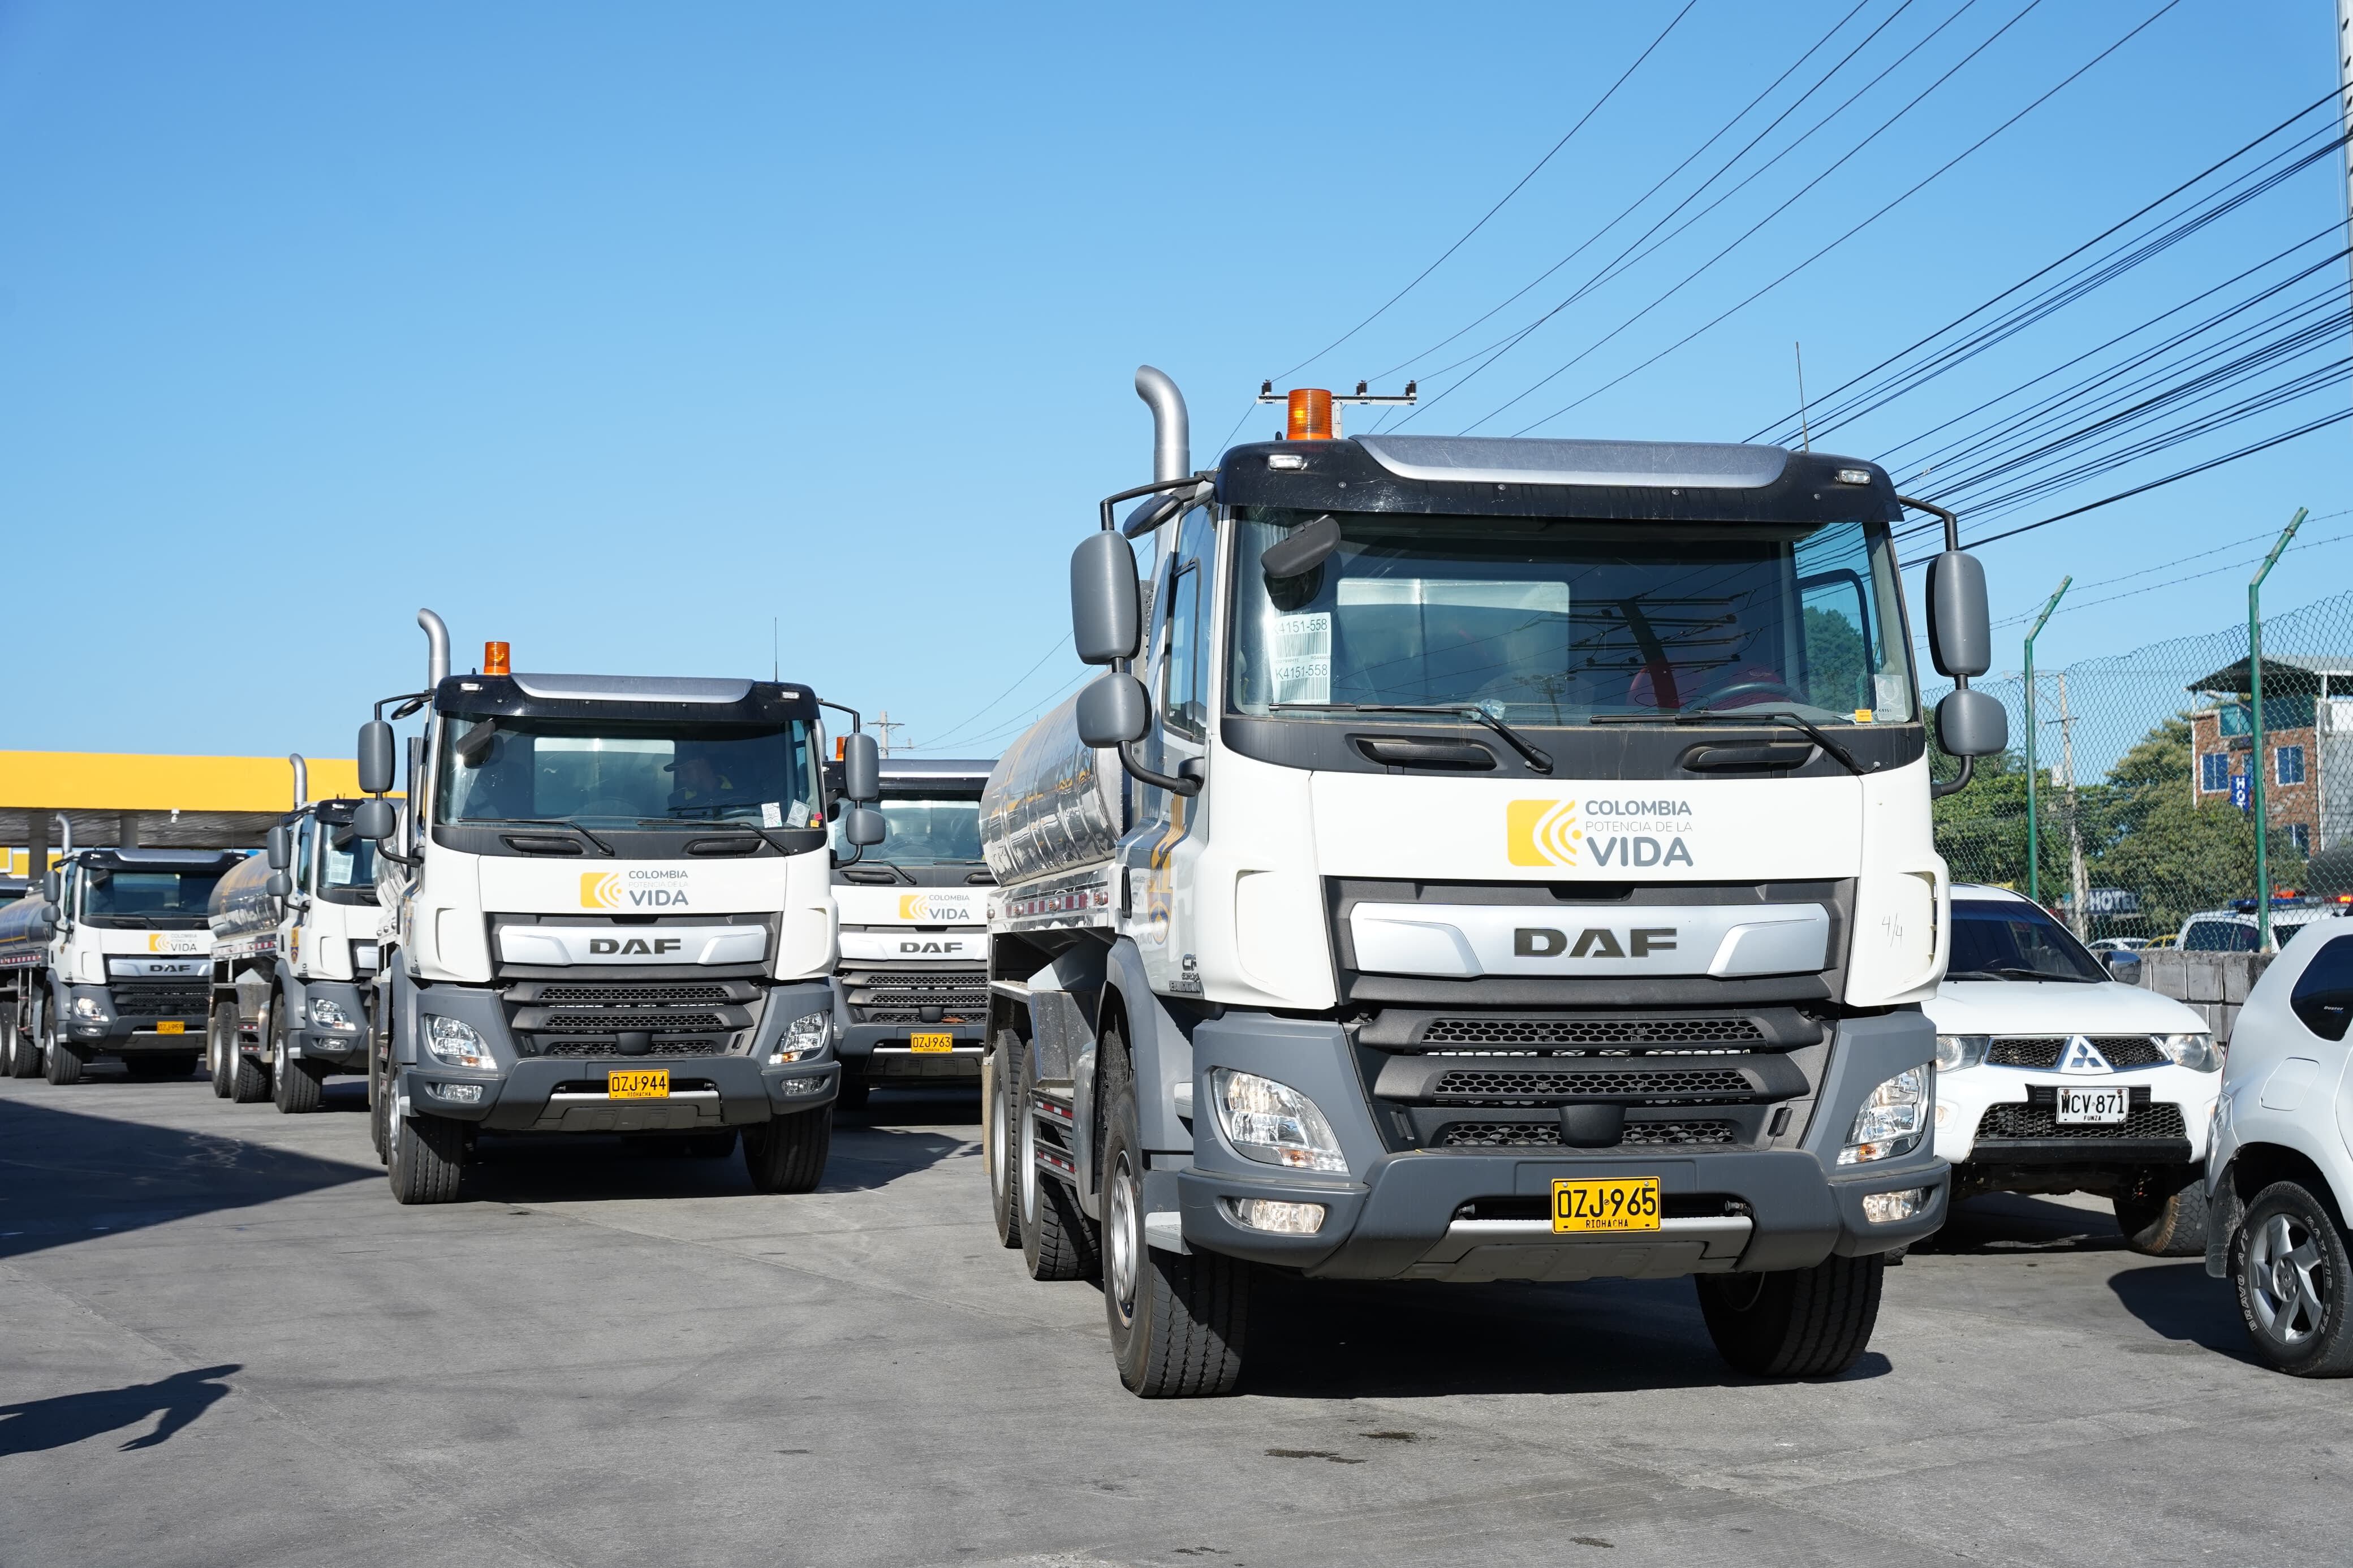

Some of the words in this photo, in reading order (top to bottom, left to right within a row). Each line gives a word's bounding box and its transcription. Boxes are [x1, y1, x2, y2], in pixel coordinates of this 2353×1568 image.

[1275, 664, 1328, 680] K4151-558
[1585, 800, 1692, 815] COLOMBIA
[1585, 822, 1652, 832] POTENCIA
[1656, 822, 1673, 832] DE
[1677, 822, 1693, 832] LA
[1586, 836, 1693, 867] VIDA
[629, 870, 688, 879] COLOMBIA
[629, 889, 689, 906] VIDA
[929, 908, 970, 919] VIDA
[1882, 912, 1902, 948] 4/4
[590, 939, 681, 954] DAF
[900, 942, 963, 953] DAF
[1514, 928, 1677, 958] DAF
[1585, 1219, 1628, 1228] RIOHACHA
[2238, 1228, 2248, 1266] A/T
[2305, 1216, 2332, 1289] MAXXIS
[2238, 1275, 2258, 1332] BRAVO
